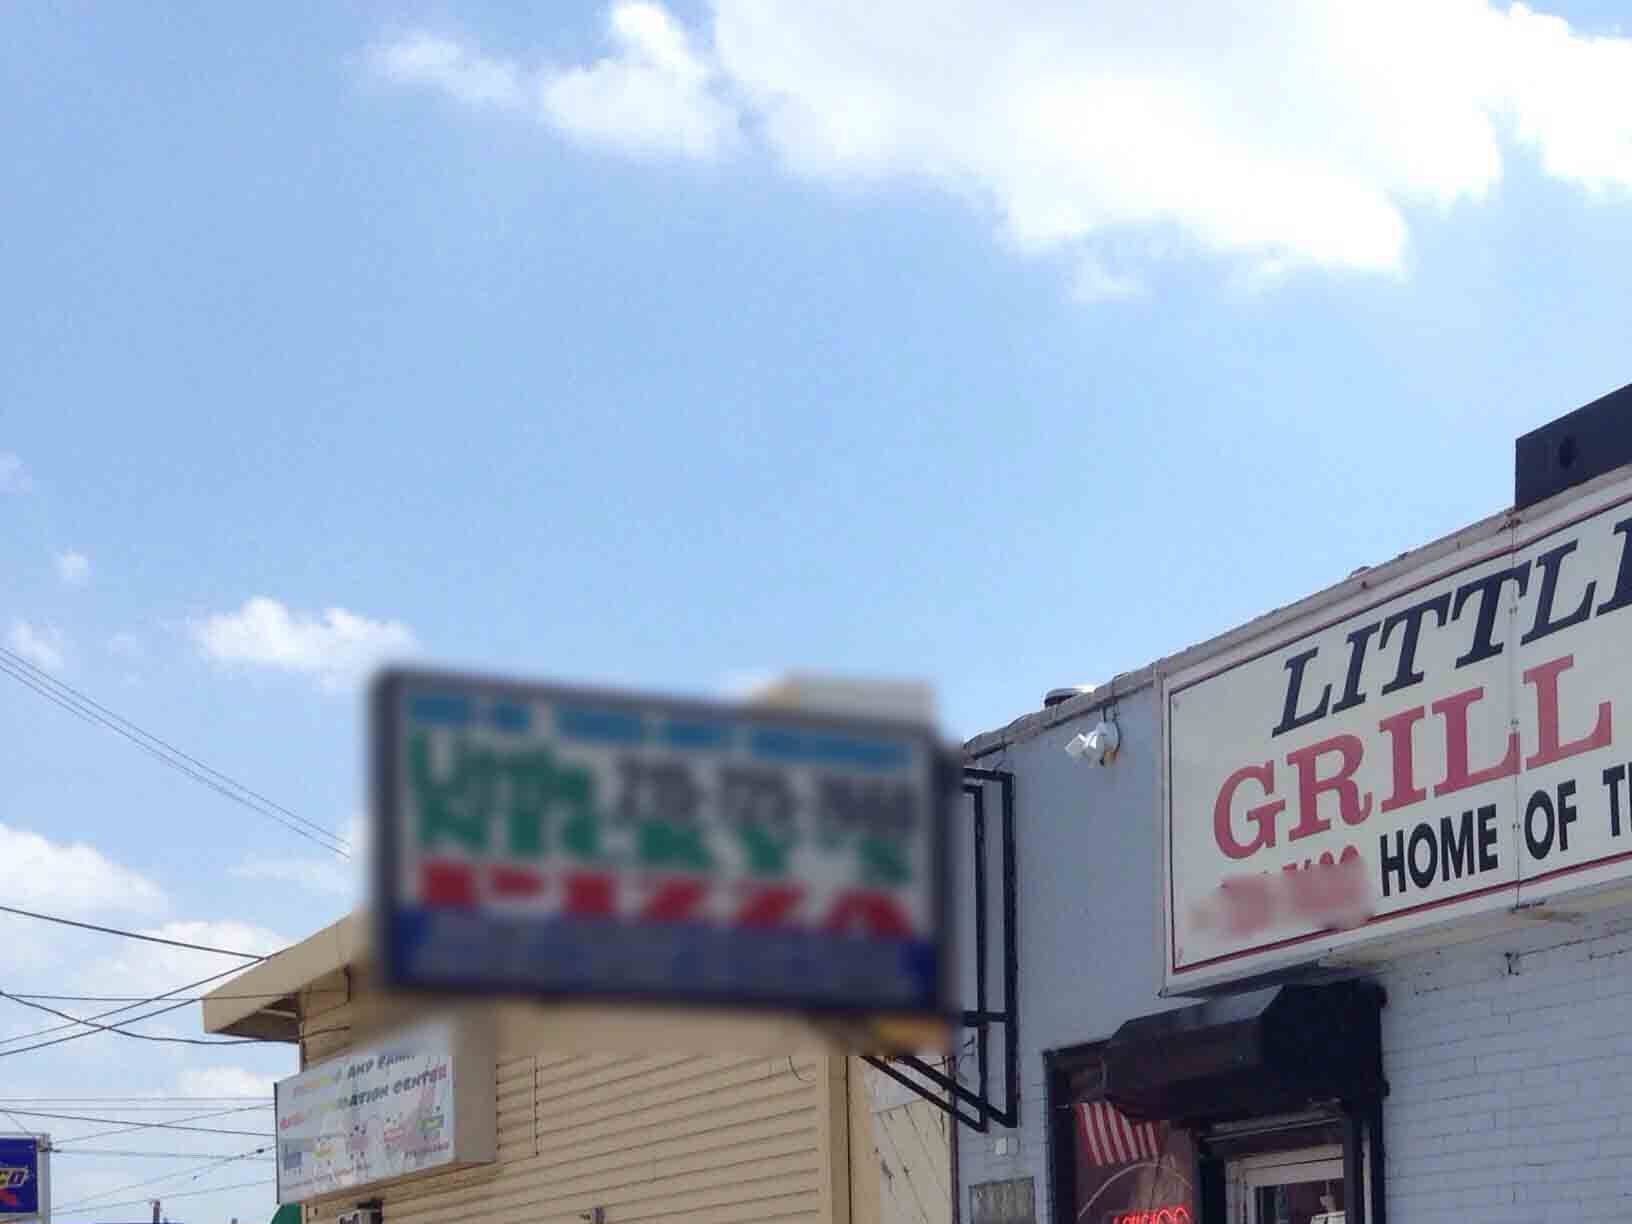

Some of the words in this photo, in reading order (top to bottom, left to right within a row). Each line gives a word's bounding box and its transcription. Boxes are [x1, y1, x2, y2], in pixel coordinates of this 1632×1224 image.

[1213, 654, 1613, 859] GRILL
[1380, 802, 1498, 897] HOME
[1525, 779, 1578, 860] OF
